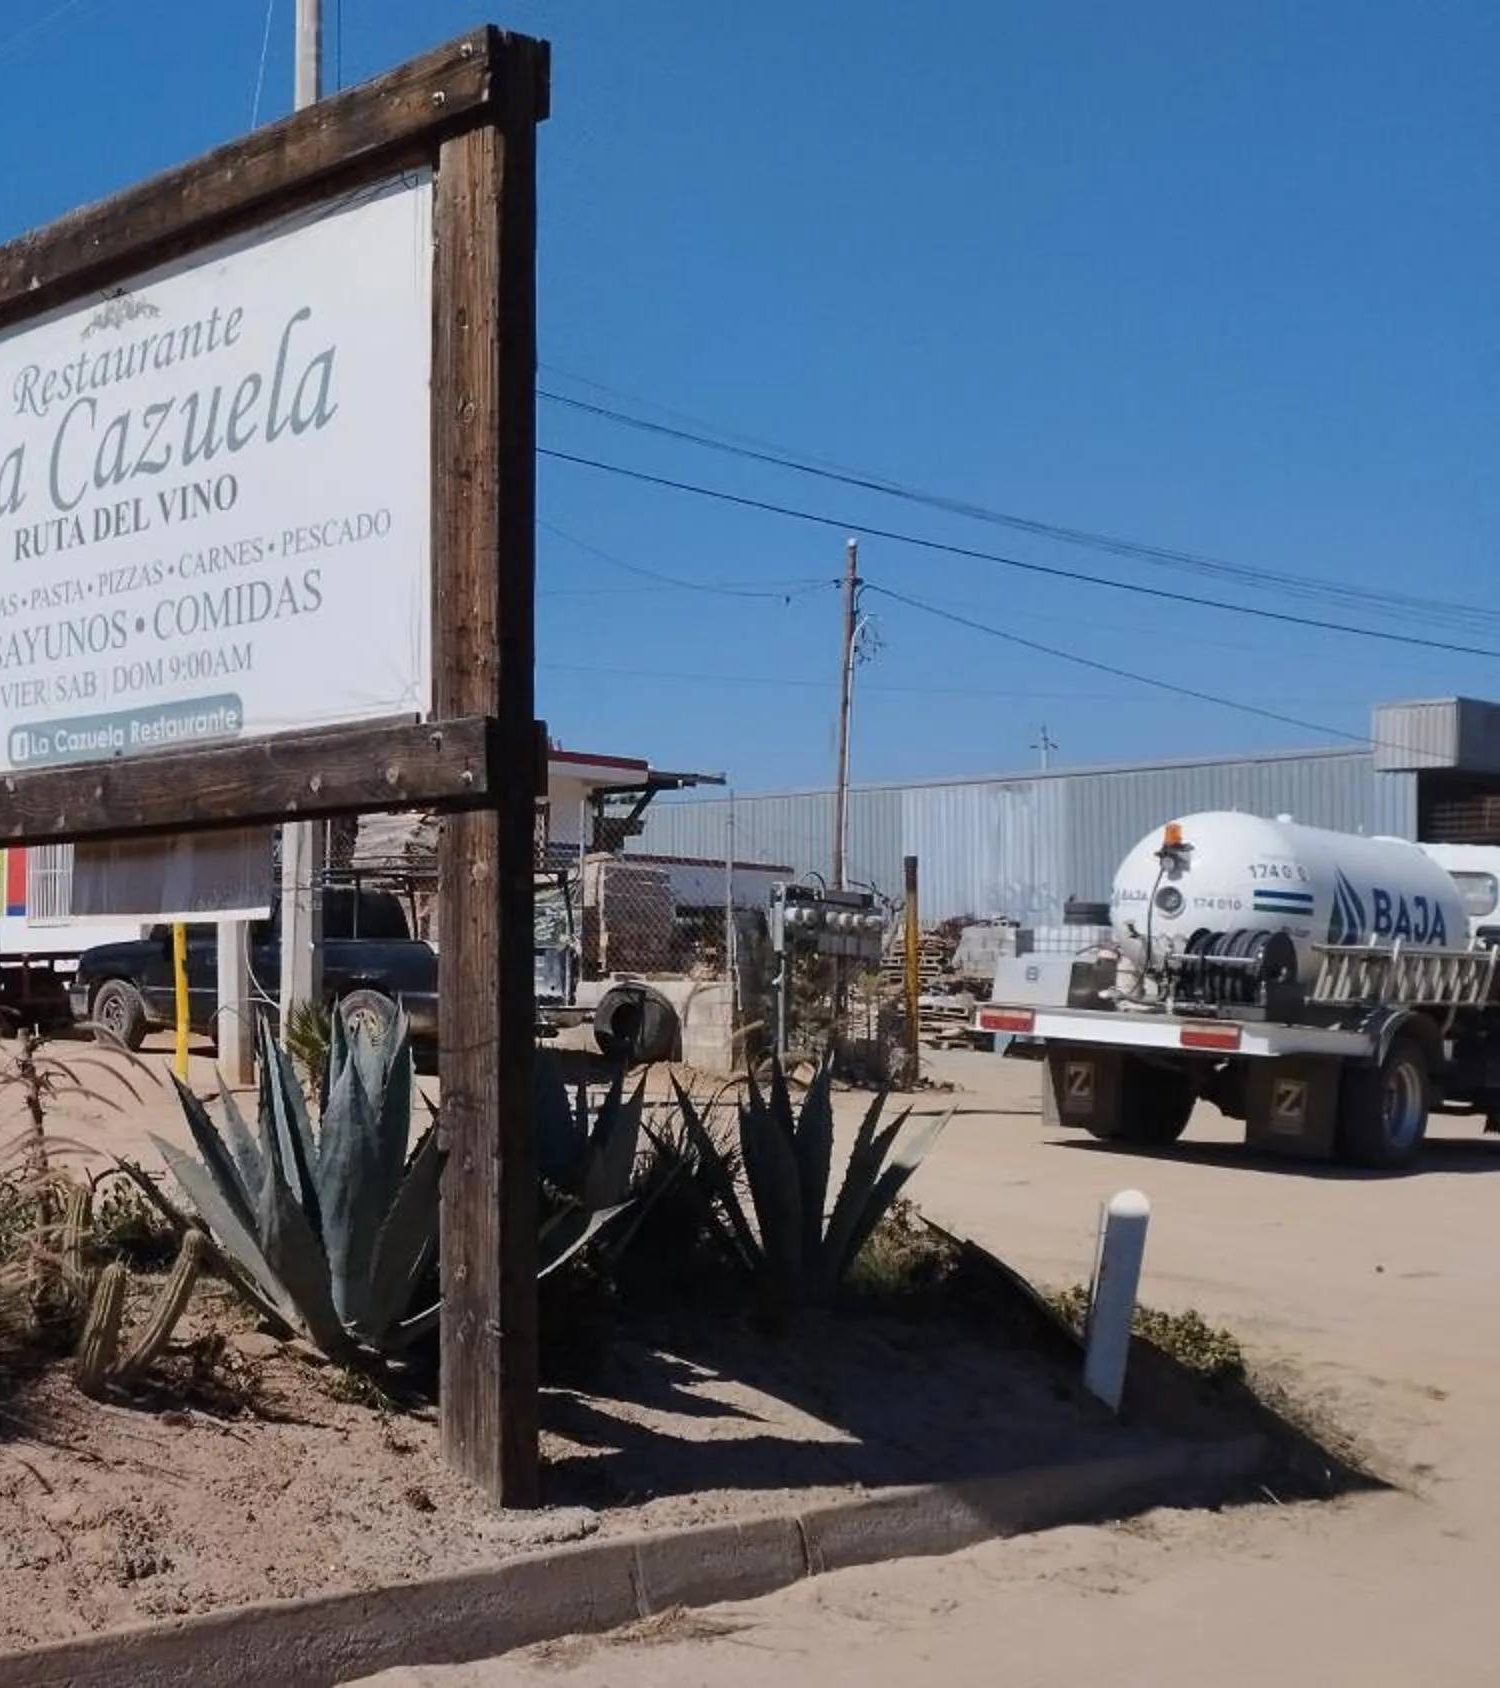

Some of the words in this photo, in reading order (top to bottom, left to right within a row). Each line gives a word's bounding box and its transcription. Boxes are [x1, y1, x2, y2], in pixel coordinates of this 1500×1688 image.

[13, 306, 243, 418] Restaurante
[48, 307, 339, 512] Cazuela
[13, 511, 86, 562] RUTA
[93, 500, 151, 542] DEL
[158, 473, 238, 524] VINO
[30, 577, 84, 609] PASTA
[98, 564, 164, 597] PIZZAS
[179, 537, 264, 580] CARNES
[282, 508, 392, 558] PESCADO
[153, 568, 323, 641] COMIDAS
[56, 671, 97, 701] SAB
[113, 664, 163, 694] DOM
[169, 642, 252, 682] 9:00AM
[31, 734, 48, 755] La
[54, 725, 123, 752] Cazuela
[130, 706, 238, 744] Restaurante
[1373, 887, 1447, 946] BAJA
[1069, 1065, 1091, 1097] Z
[1276, 1083, 1301, 1117] Z
